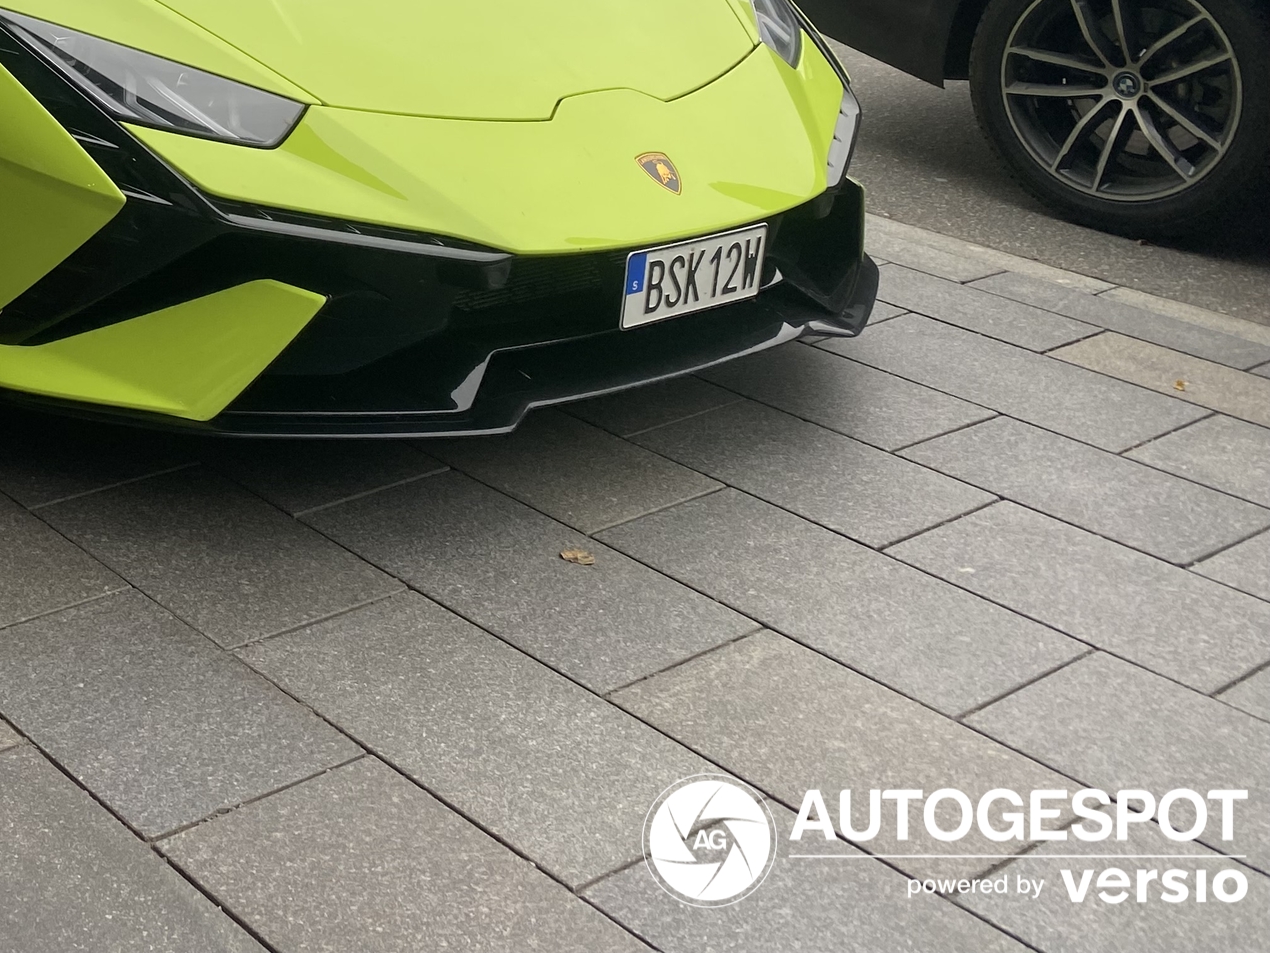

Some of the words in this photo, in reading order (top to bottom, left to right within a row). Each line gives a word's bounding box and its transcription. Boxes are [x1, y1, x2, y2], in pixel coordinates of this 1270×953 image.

[632, 280, 639, 291] S
[644, 249, 706, 315] BSK
[709, 236, 762, 298] 12W
